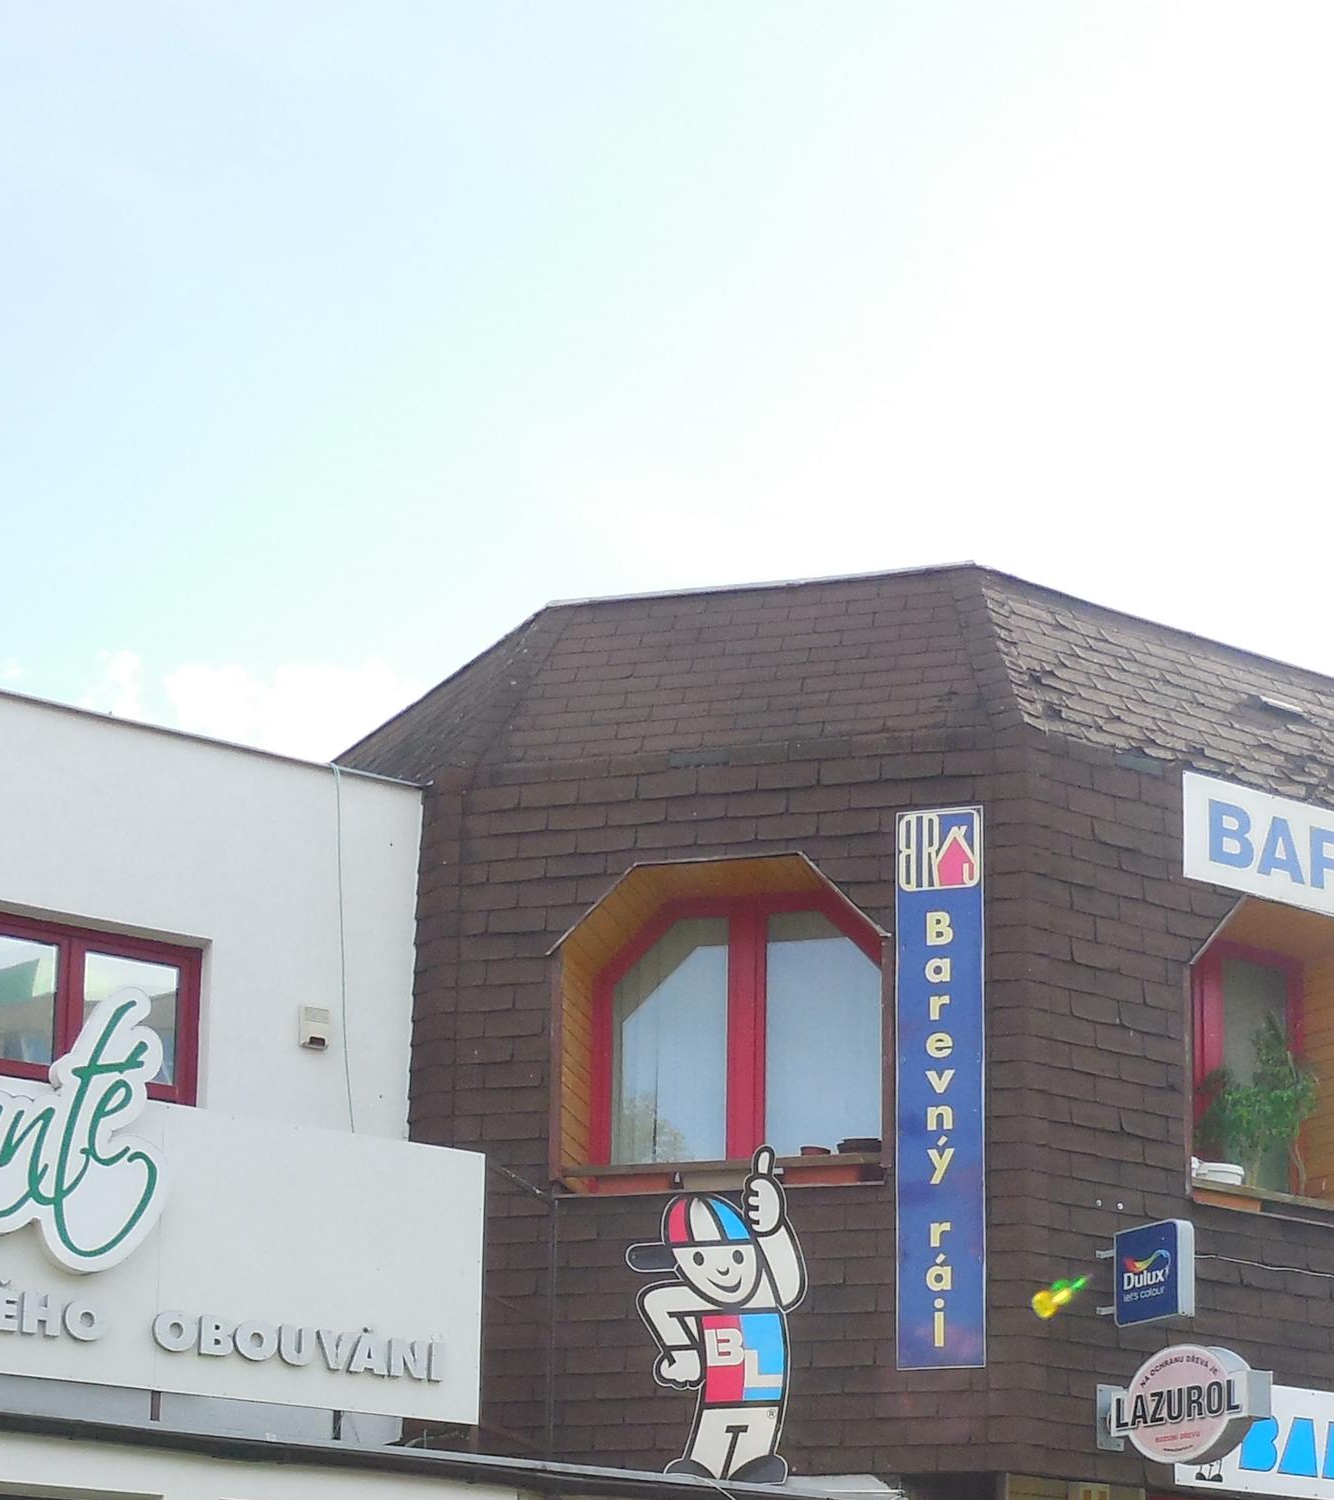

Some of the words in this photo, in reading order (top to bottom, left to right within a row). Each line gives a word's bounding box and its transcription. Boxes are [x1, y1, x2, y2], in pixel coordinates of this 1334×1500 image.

[924, 911, 954, 1185] Barevný
[1123, 1268, 1166, 1291] Dulux
[1139, 1286, 1165, 1300] colour
[1150, 1354, 1184, 1377] OCHRANU
[1114, 1378, 1241, 1429] LAZUROL
